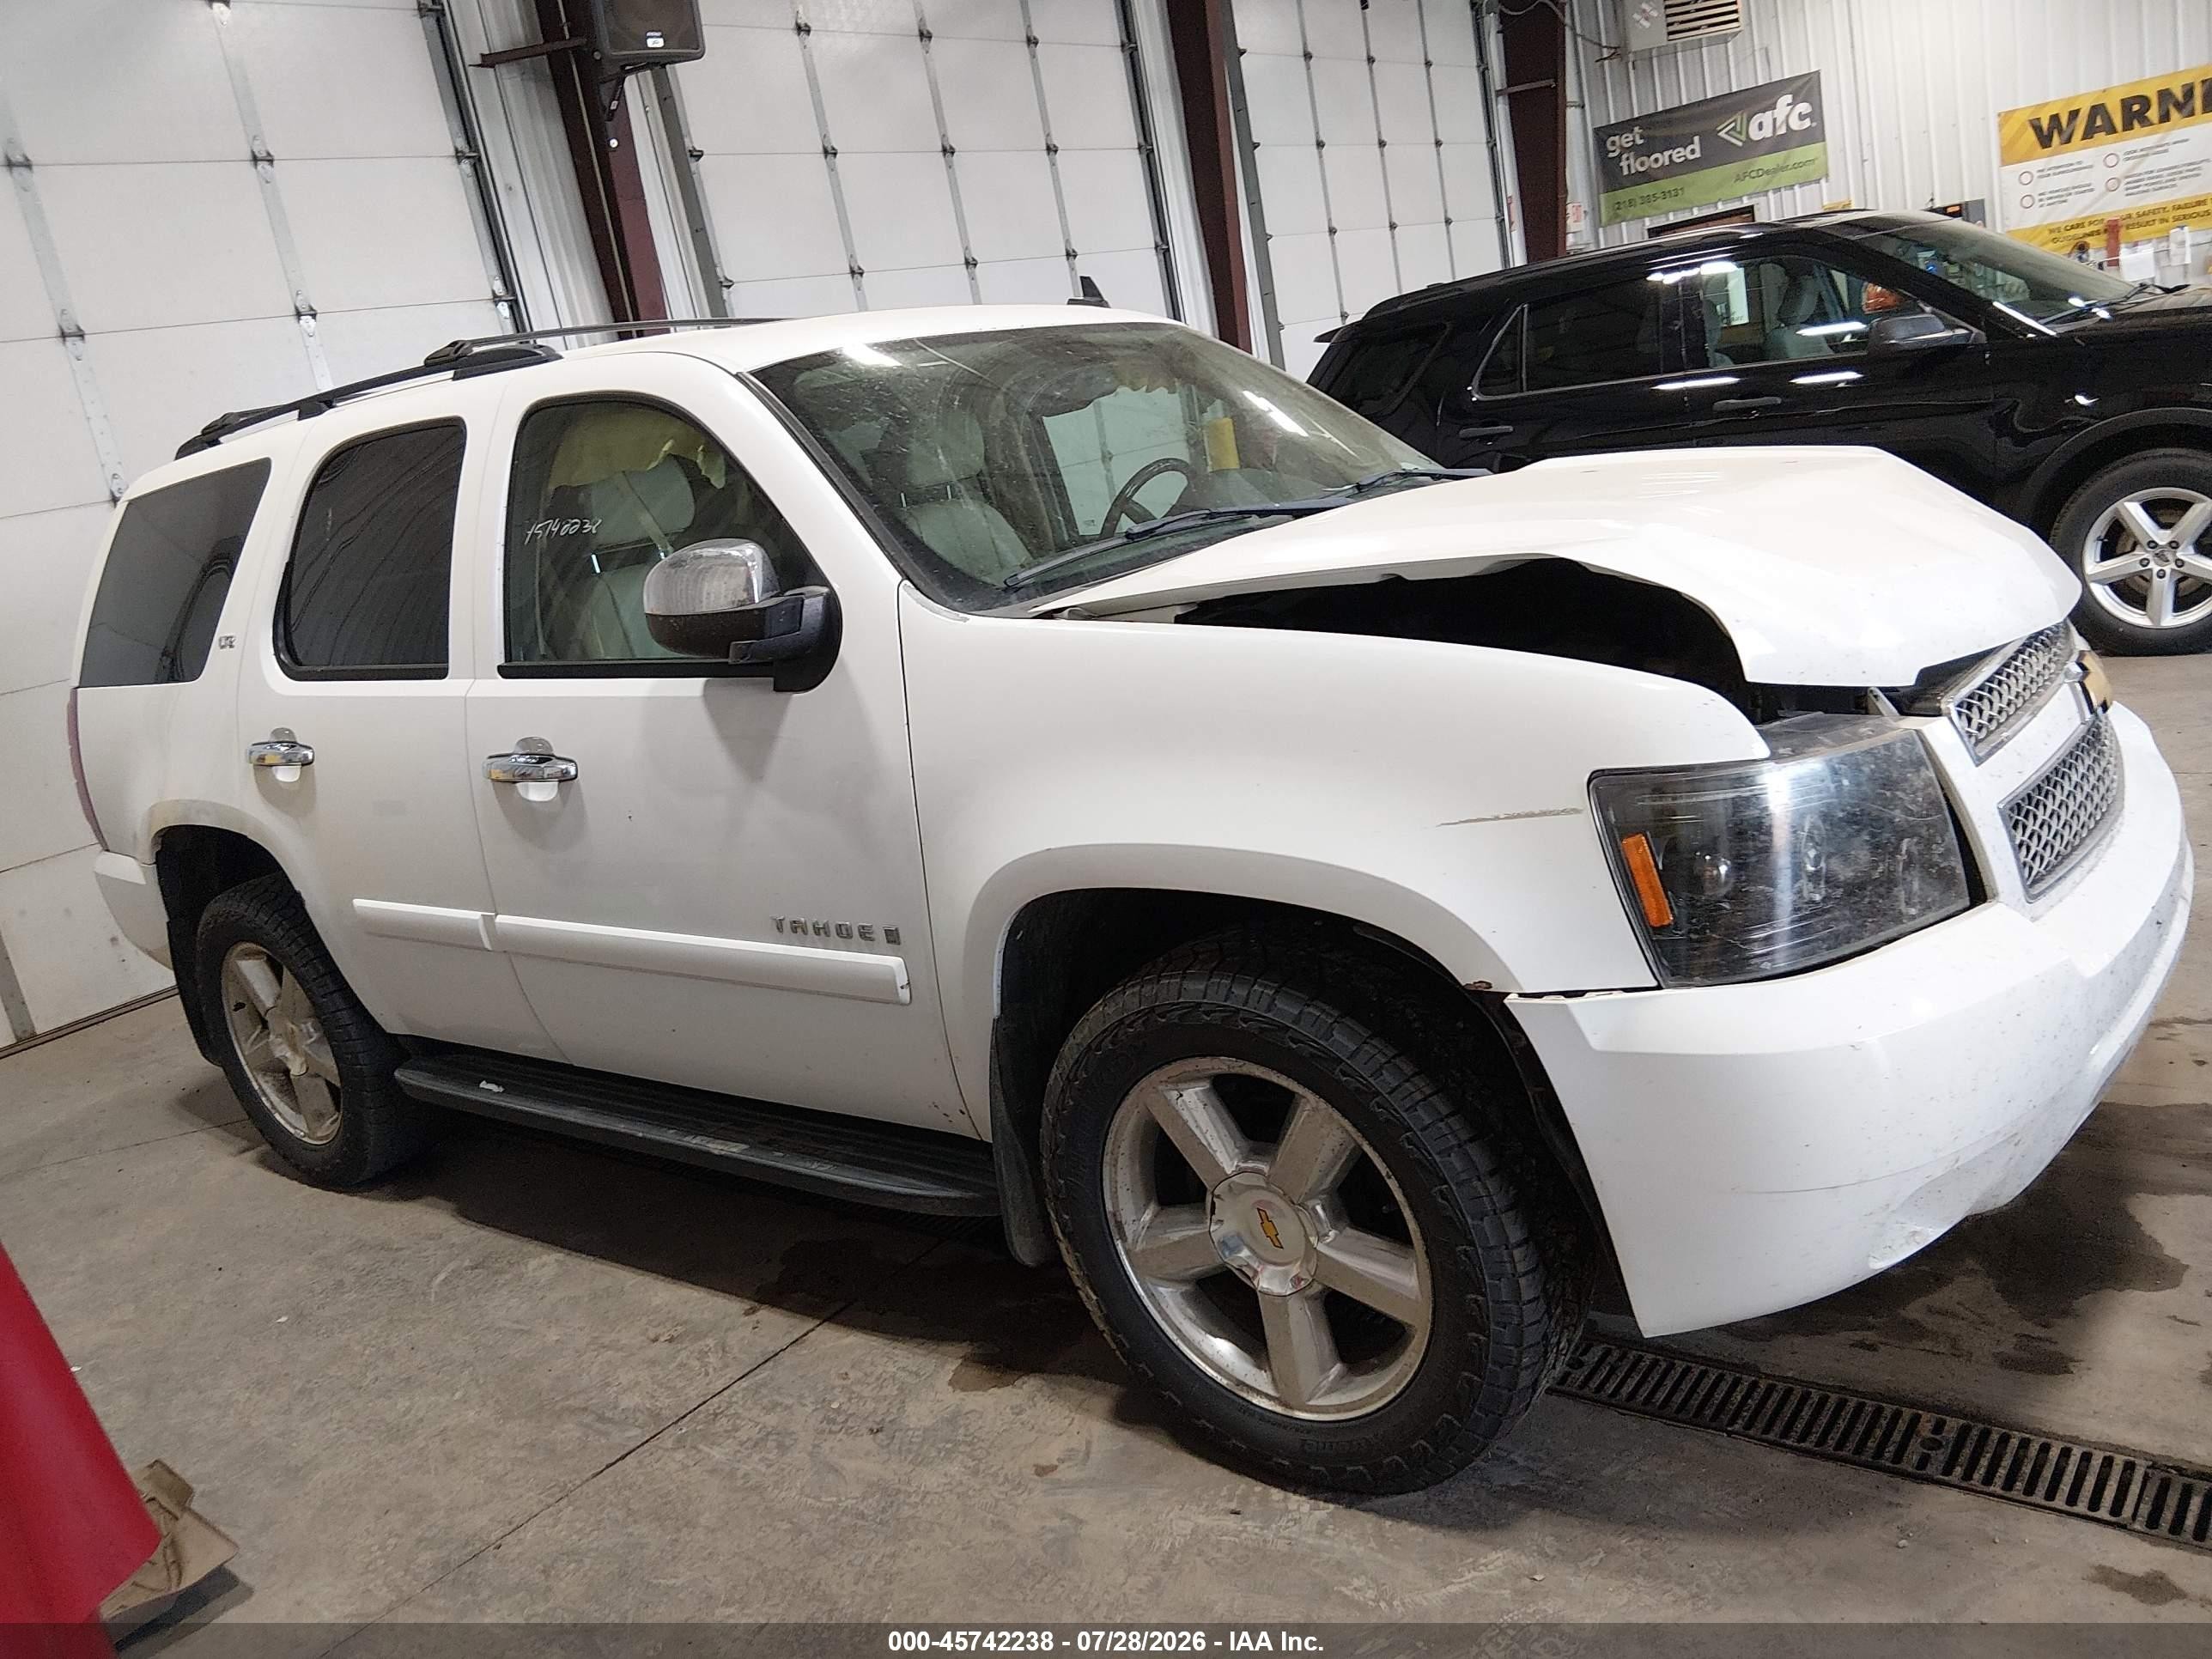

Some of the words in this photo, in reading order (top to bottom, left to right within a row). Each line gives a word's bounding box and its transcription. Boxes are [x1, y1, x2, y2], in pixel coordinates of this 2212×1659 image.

[1747, 94, 1814, 142] afc
[1606, 125, 1645, 158] get
[1620, 135, 1702, 176] floored
[1733, 157, 1817, 183] AFCDealer.com
[2063, 222, 2086, 232] CARE
[2172, 209, 2212, 222] SERIOUS
[770, 915, 876, 942] TAHOE
